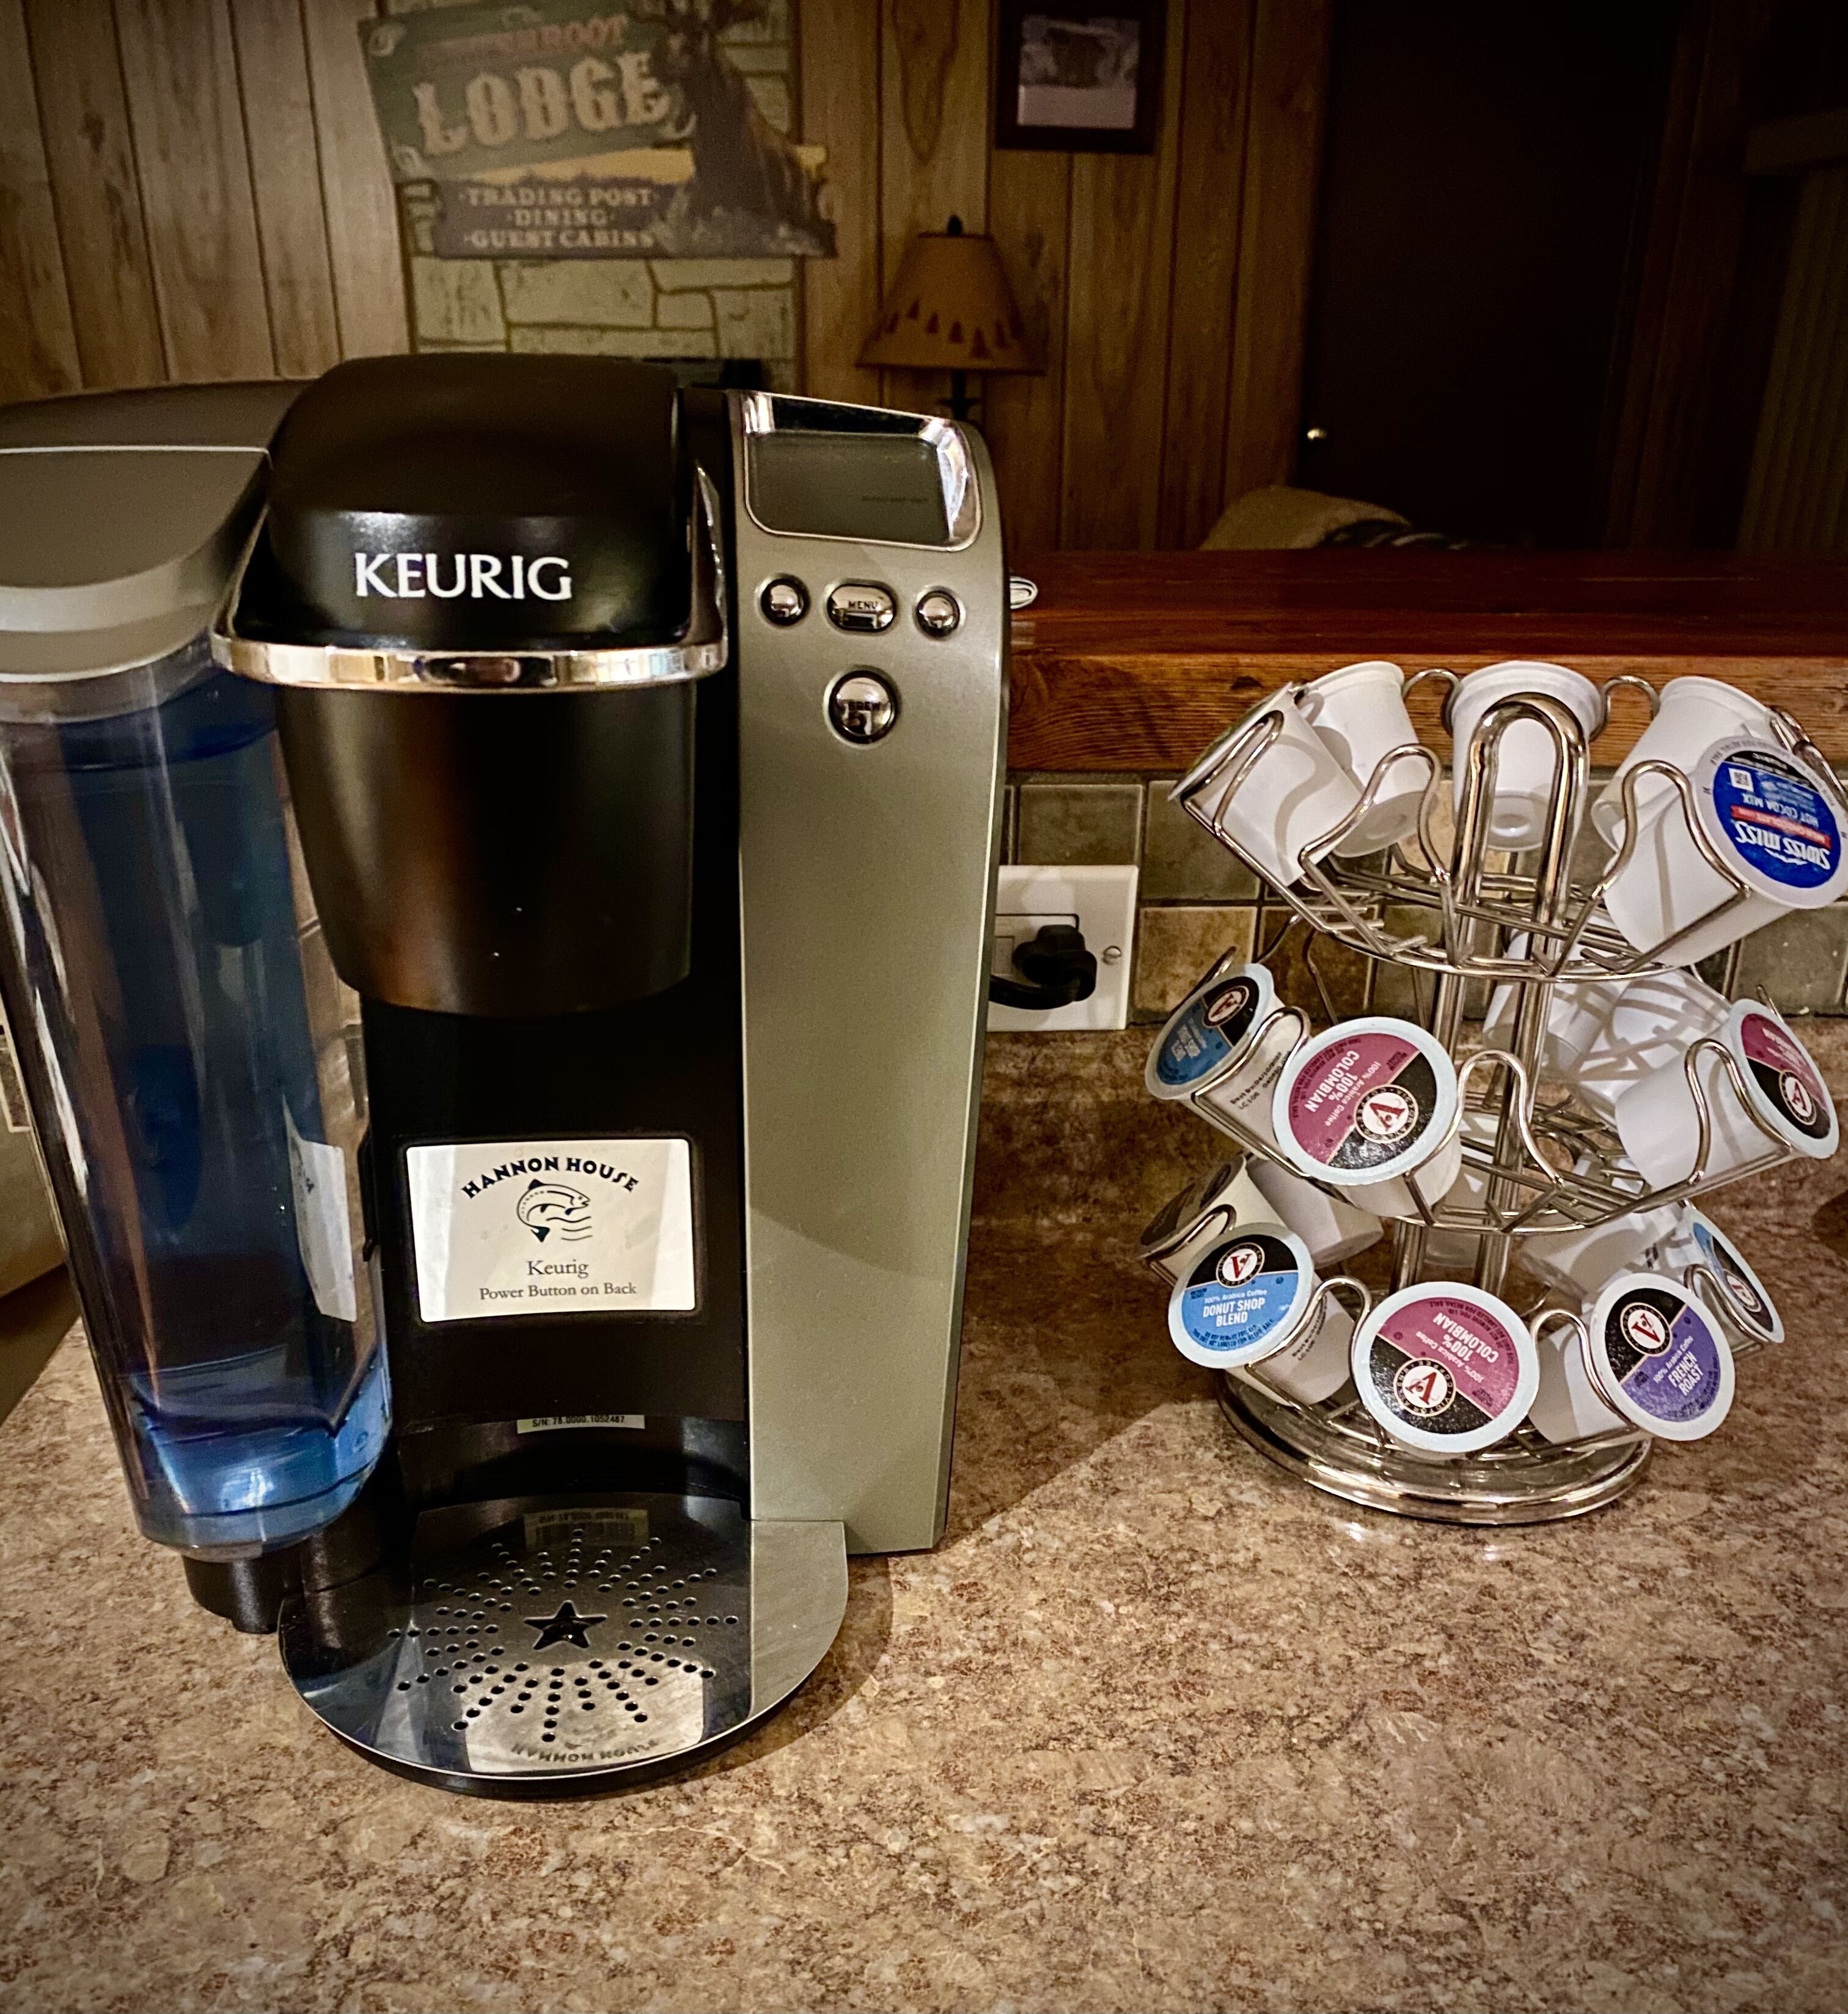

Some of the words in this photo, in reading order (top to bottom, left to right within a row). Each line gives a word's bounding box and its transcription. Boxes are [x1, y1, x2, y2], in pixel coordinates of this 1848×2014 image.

[413, 51, 670, 155] LODGE
[466, 187, 583, 207] TRADING
[588, 186, 652, 206] POST
[513, 208, 608, 227] DINING
[469, 230, 552, 248] GUEST
[355, 553, 572, 600] KEURIG
[848, 601, 878, 609] MENU
[1734, 821, 1780, 850] MISS
[1783, 837, 1830, 870] SWISS
[1304, 1049, 1360, 1114] COLOMBIAN
[1362, 1060, 1382, 1081] 100%
[1327, 1071, 1358, 1104] 100%
[1341, 1078, 1365, 1106] Arabica
[1324, 1103, 1345, 1127] Coffee
[461, 1156, 559, 1199] HANNON
[565, 1157, 639, 1193] HOUSE
[526, 1259, 589, 1278] Keurig
[480, 1287, 524, 1300] Power
[529, 1285, 576, 1296] Button
[581, 1286, 599, 1295] on
[604, 1282, 637, 1295] Back
[1203, 1301, 1235, 1318] DONUT
[1238, 1297, 1265, 1312] SHOP
[1216, 1311, 1248, 1328] BLEND
[1415, 1330, 1439, 1350] Coffee
[1432, 1311, 1500, 1364] COLOMBIAN
[1439, 1332, 1475, 1363] 100%
[1436, 1345, 1465, 1369] Arabica
[1668, 1351, 1698, 1387] FRENCH
[1462, 1364, 1484, 1383] 100%
[1652, 1366, 1669, 1384] 100%
[1678, 1364, 1704, 1397] ROAST
